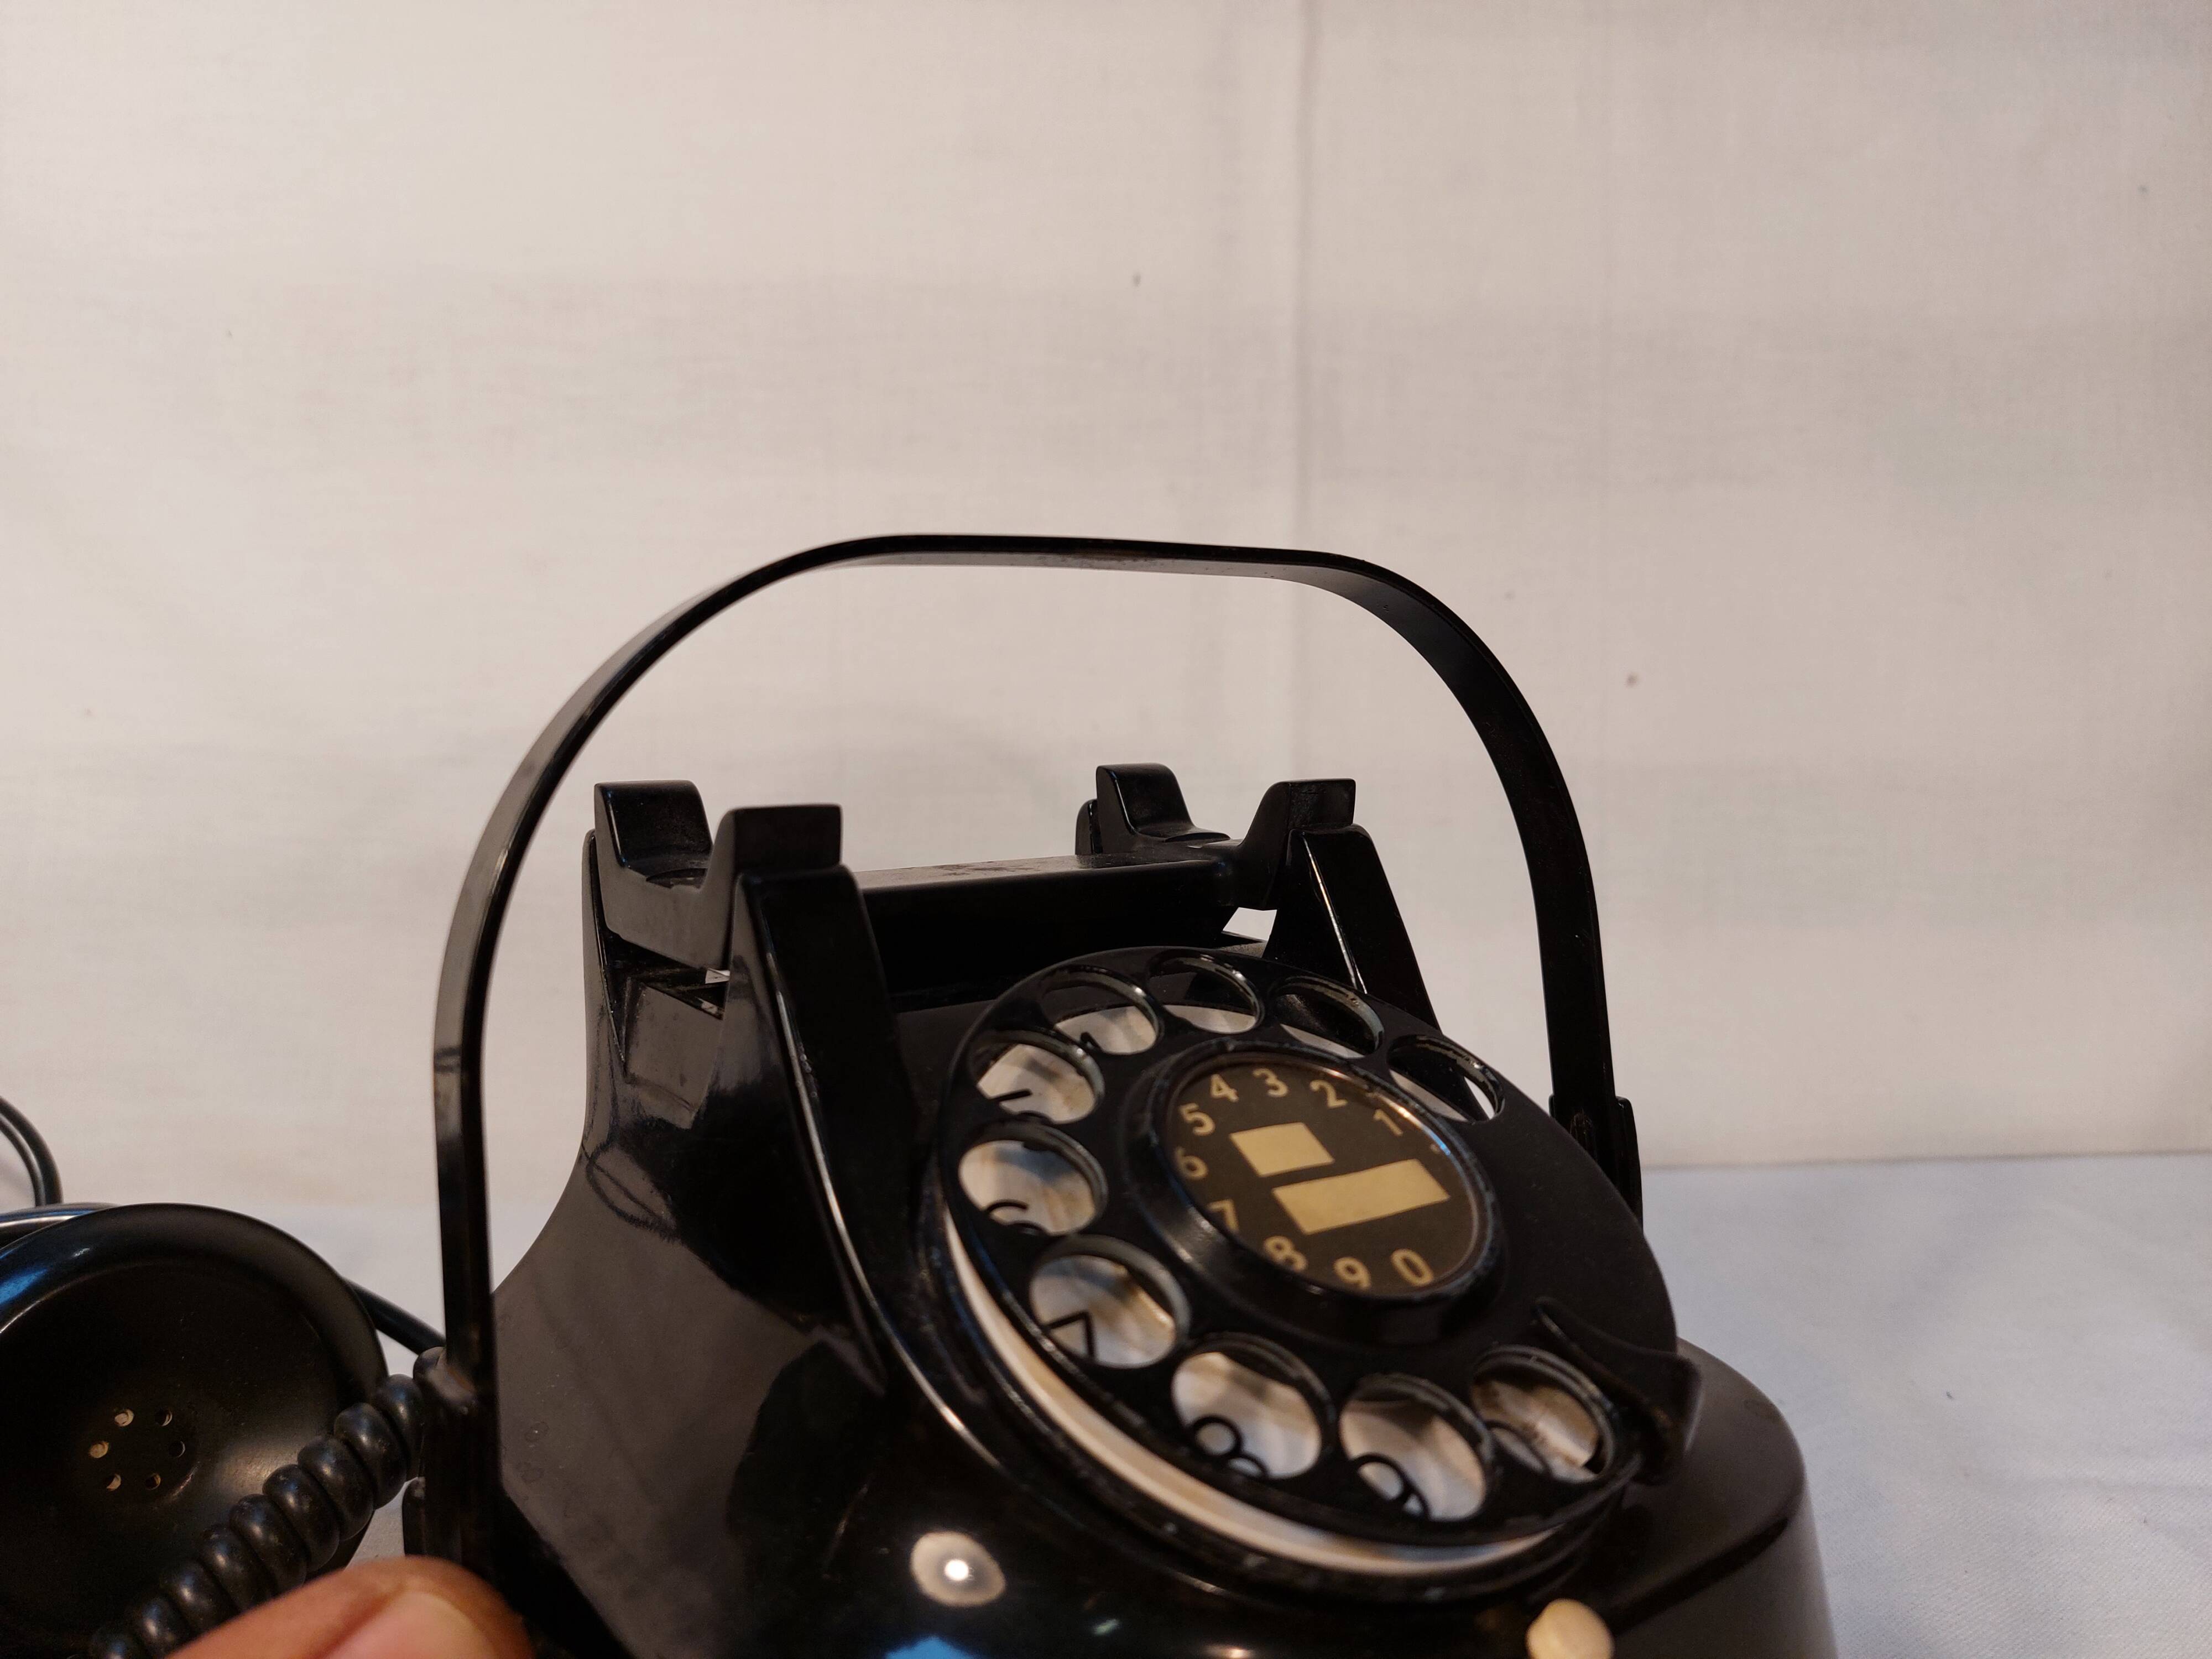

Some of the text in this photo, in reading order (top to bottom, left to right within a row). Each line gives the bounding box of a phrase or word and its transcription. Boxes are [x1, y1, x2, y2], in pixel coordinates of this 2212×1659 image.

[1210, 1074, 1239, 1102] 4
[1254, 1068, 1288, 1097] 3
[1311, 1081, 1348, 1108] 2
[1180, 1104, 1215, 1136] 5
[1373, 1109, 1404, 1136] 1
[1176, 1149, 1207, 1180] 6
[1208, 1199, 1240, 1232] 7
[1264, 1236, 1307, 1271] 8
[1391, 1249, 1433, 1286] 0
[1334, 1257, 1371, 1289] 9
